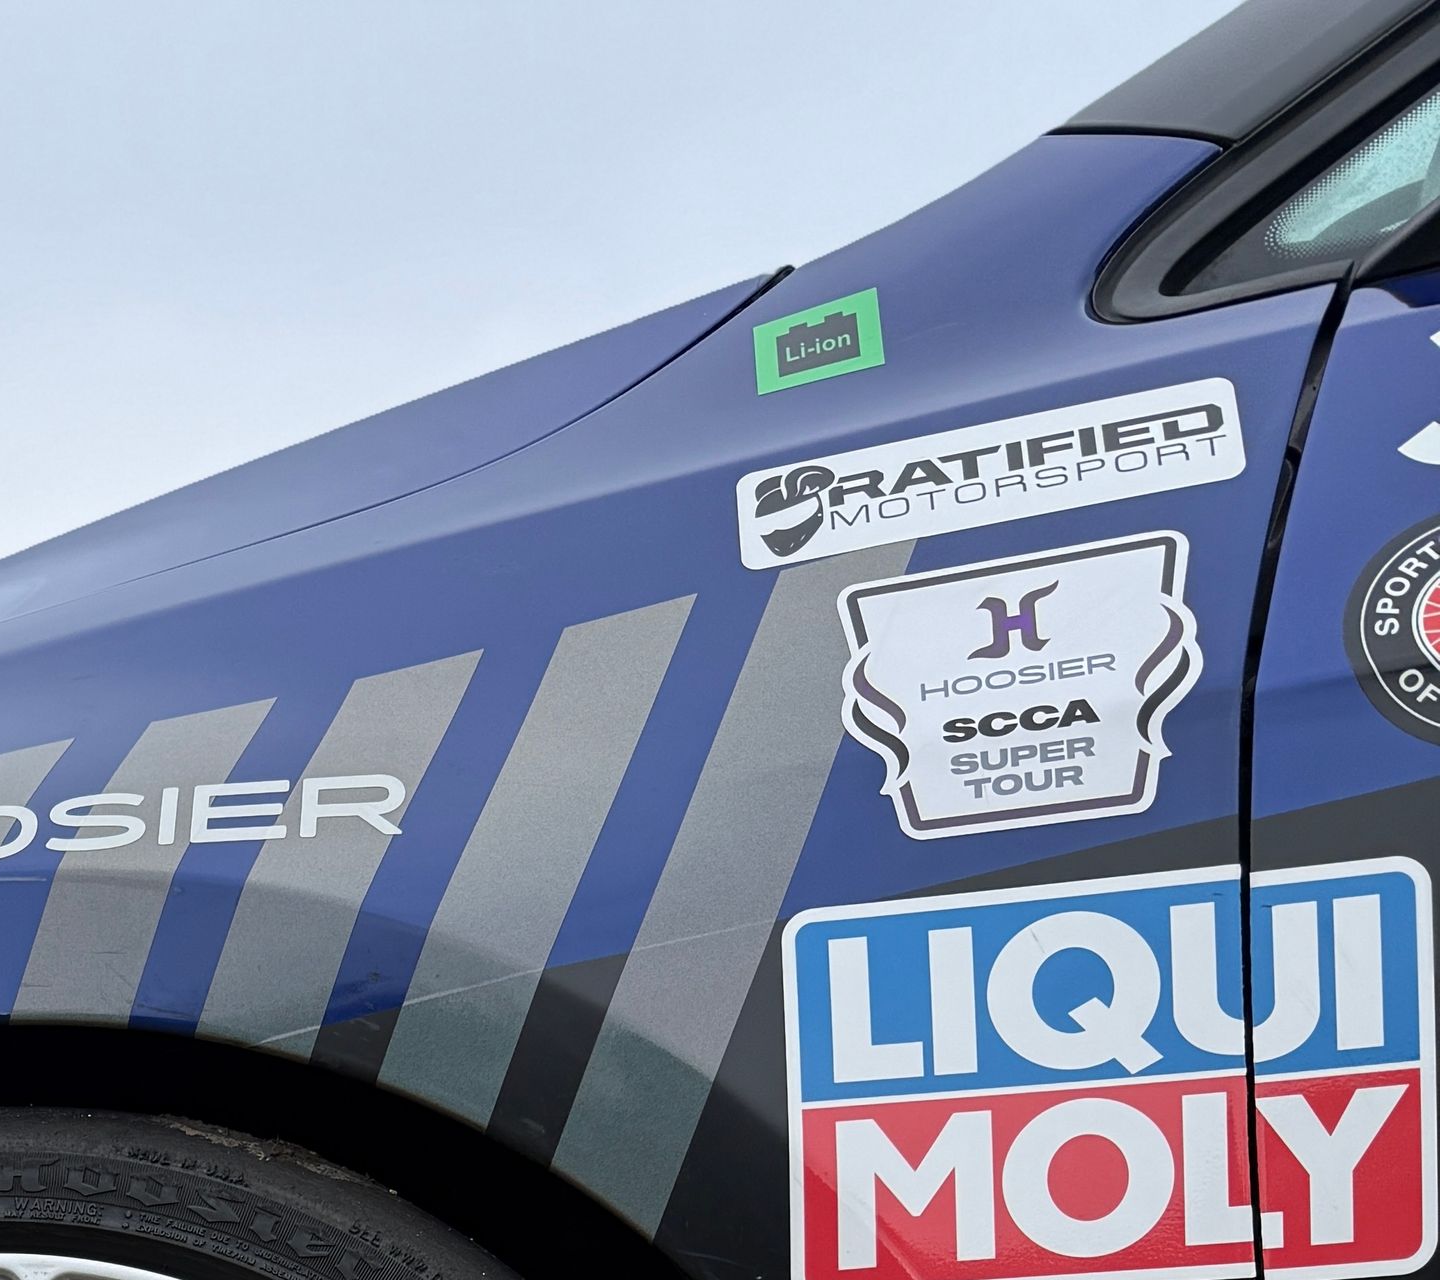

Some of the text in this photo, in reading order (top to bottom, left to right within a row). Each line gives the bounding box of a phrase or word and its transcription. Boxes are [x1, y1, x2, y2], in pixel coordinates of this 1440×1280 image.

[785, 331, 852, 362] Li-ion
[830, 434, 1228, 531] MOTORSPORT
[920, 653, 1117, 702] HOOSIER
[942, 699, 1101, 743] SCCA
[950, 737, 1096, 776] SUPER
[963, 765, 1084, 800] TOUR
[827, 893, 1385, 1084] LIQUI
[835, 1084, 1410, 1271] MOLY
[13, 1197, 106, 1216] WARNING:
